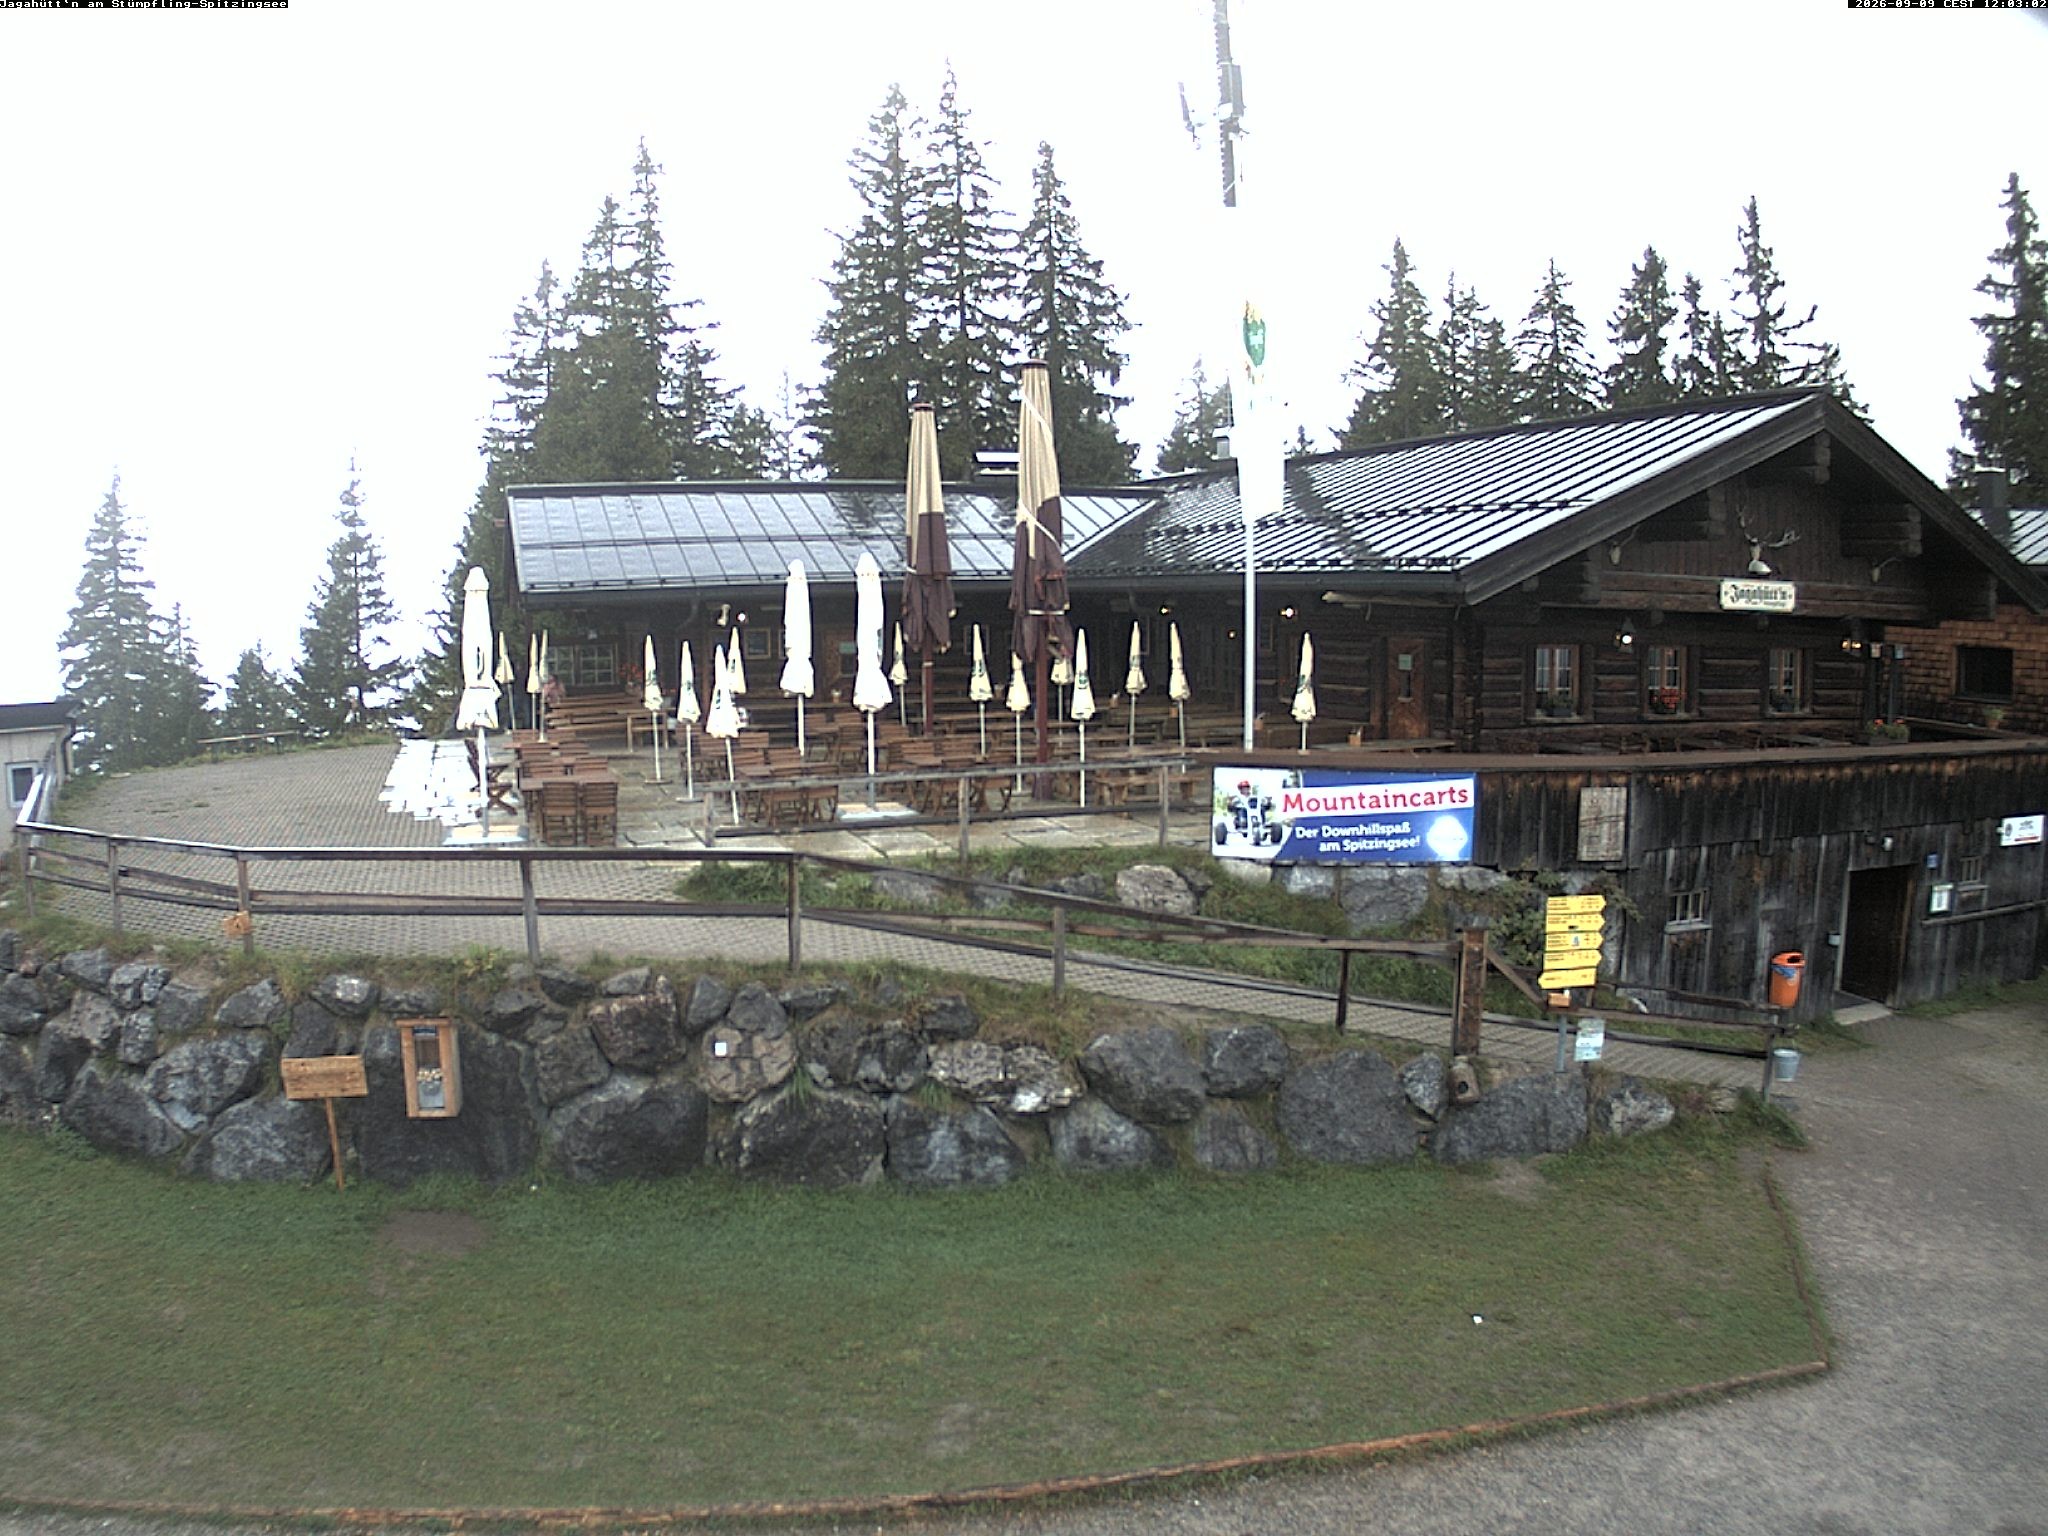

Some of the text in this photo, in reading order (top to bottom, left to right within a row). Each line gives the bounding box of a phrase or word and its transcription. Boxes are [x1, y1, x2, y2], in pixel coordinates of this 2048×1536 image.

[1283, 787, 1468, 813] Mountaincarts
[1295, 821, 1411, 839] Der Downhillspaß
[1319, 836, 1420, 853] am Spitzingsee!
